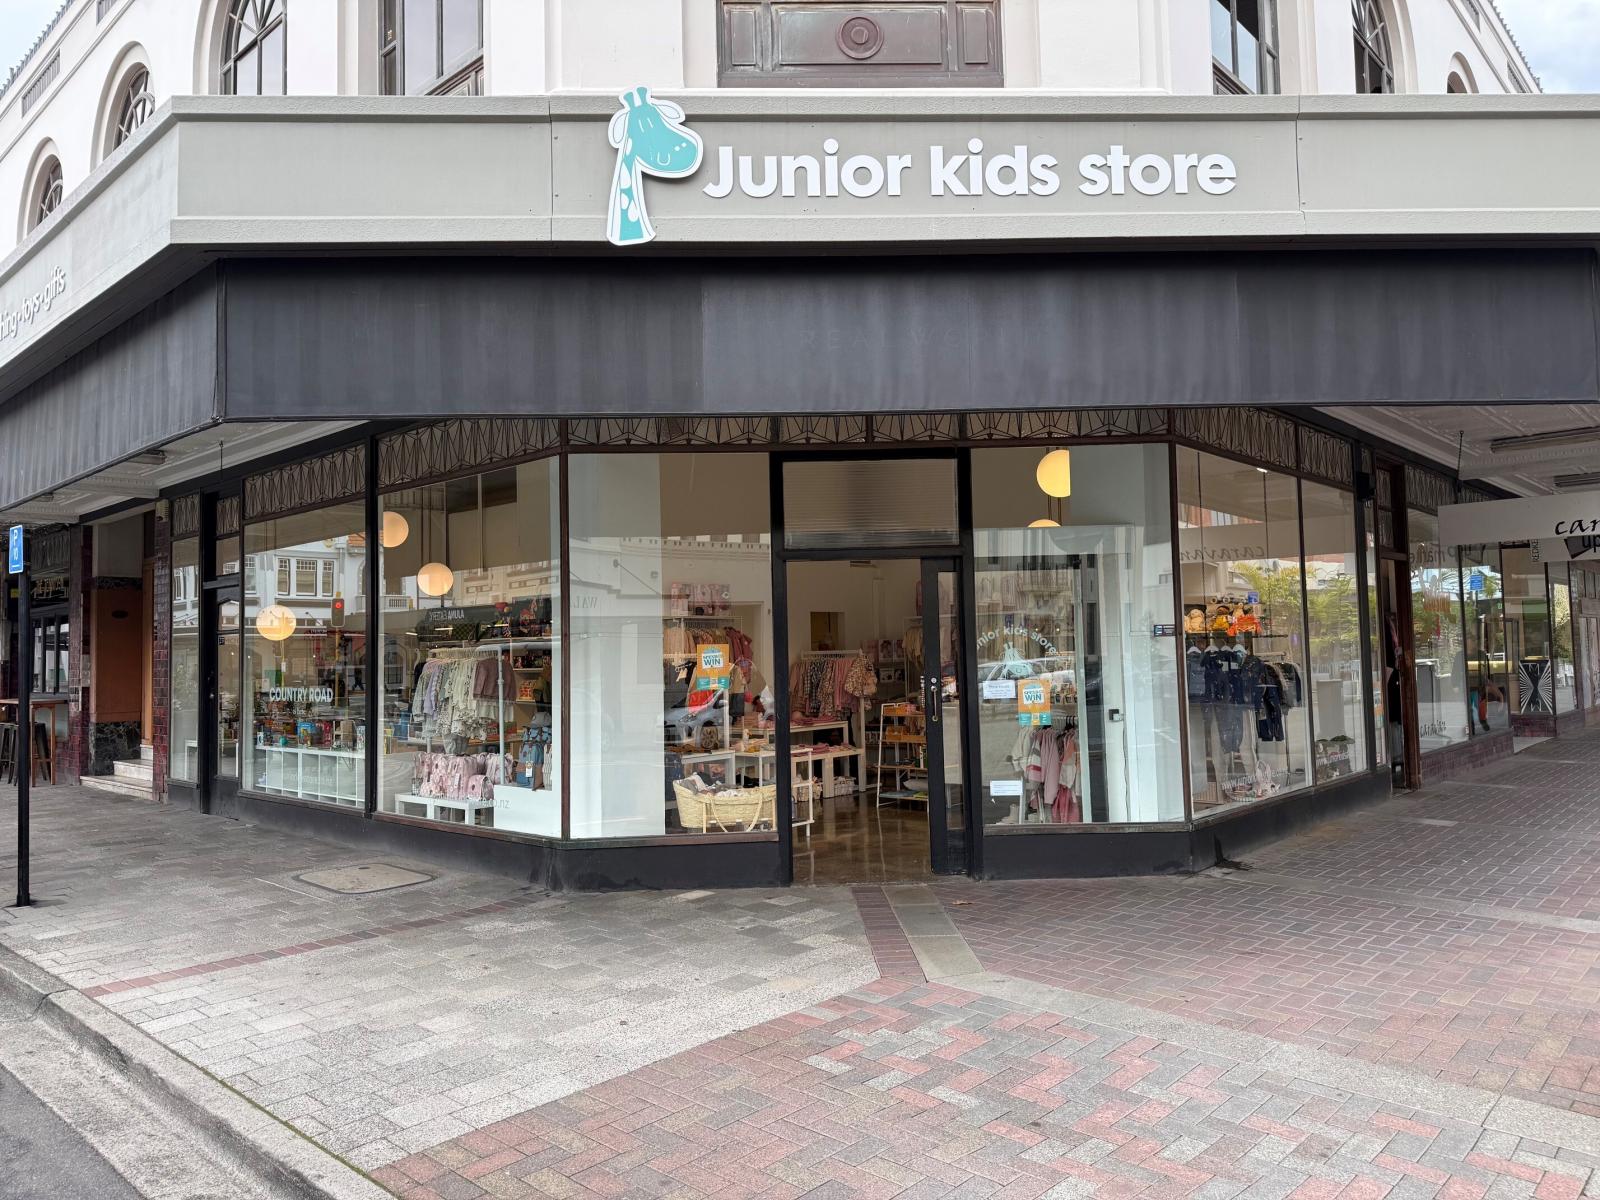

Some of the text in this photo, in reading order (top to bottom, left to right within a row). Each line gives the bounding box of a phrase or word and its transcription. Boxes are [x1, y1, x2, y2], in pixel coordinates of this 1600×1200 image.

[702, 138, 1237, 198] Junior kids store
[13, 529, 19, 546] P
[1003, 624, 1028, 637] kids
[1030, 631, 1057, 654] store
[703, 658, 721, 666] WIN
[269, 687, 332, 702] COUNTRY ROAD
[1024, 693, 1042, 702] WIN
